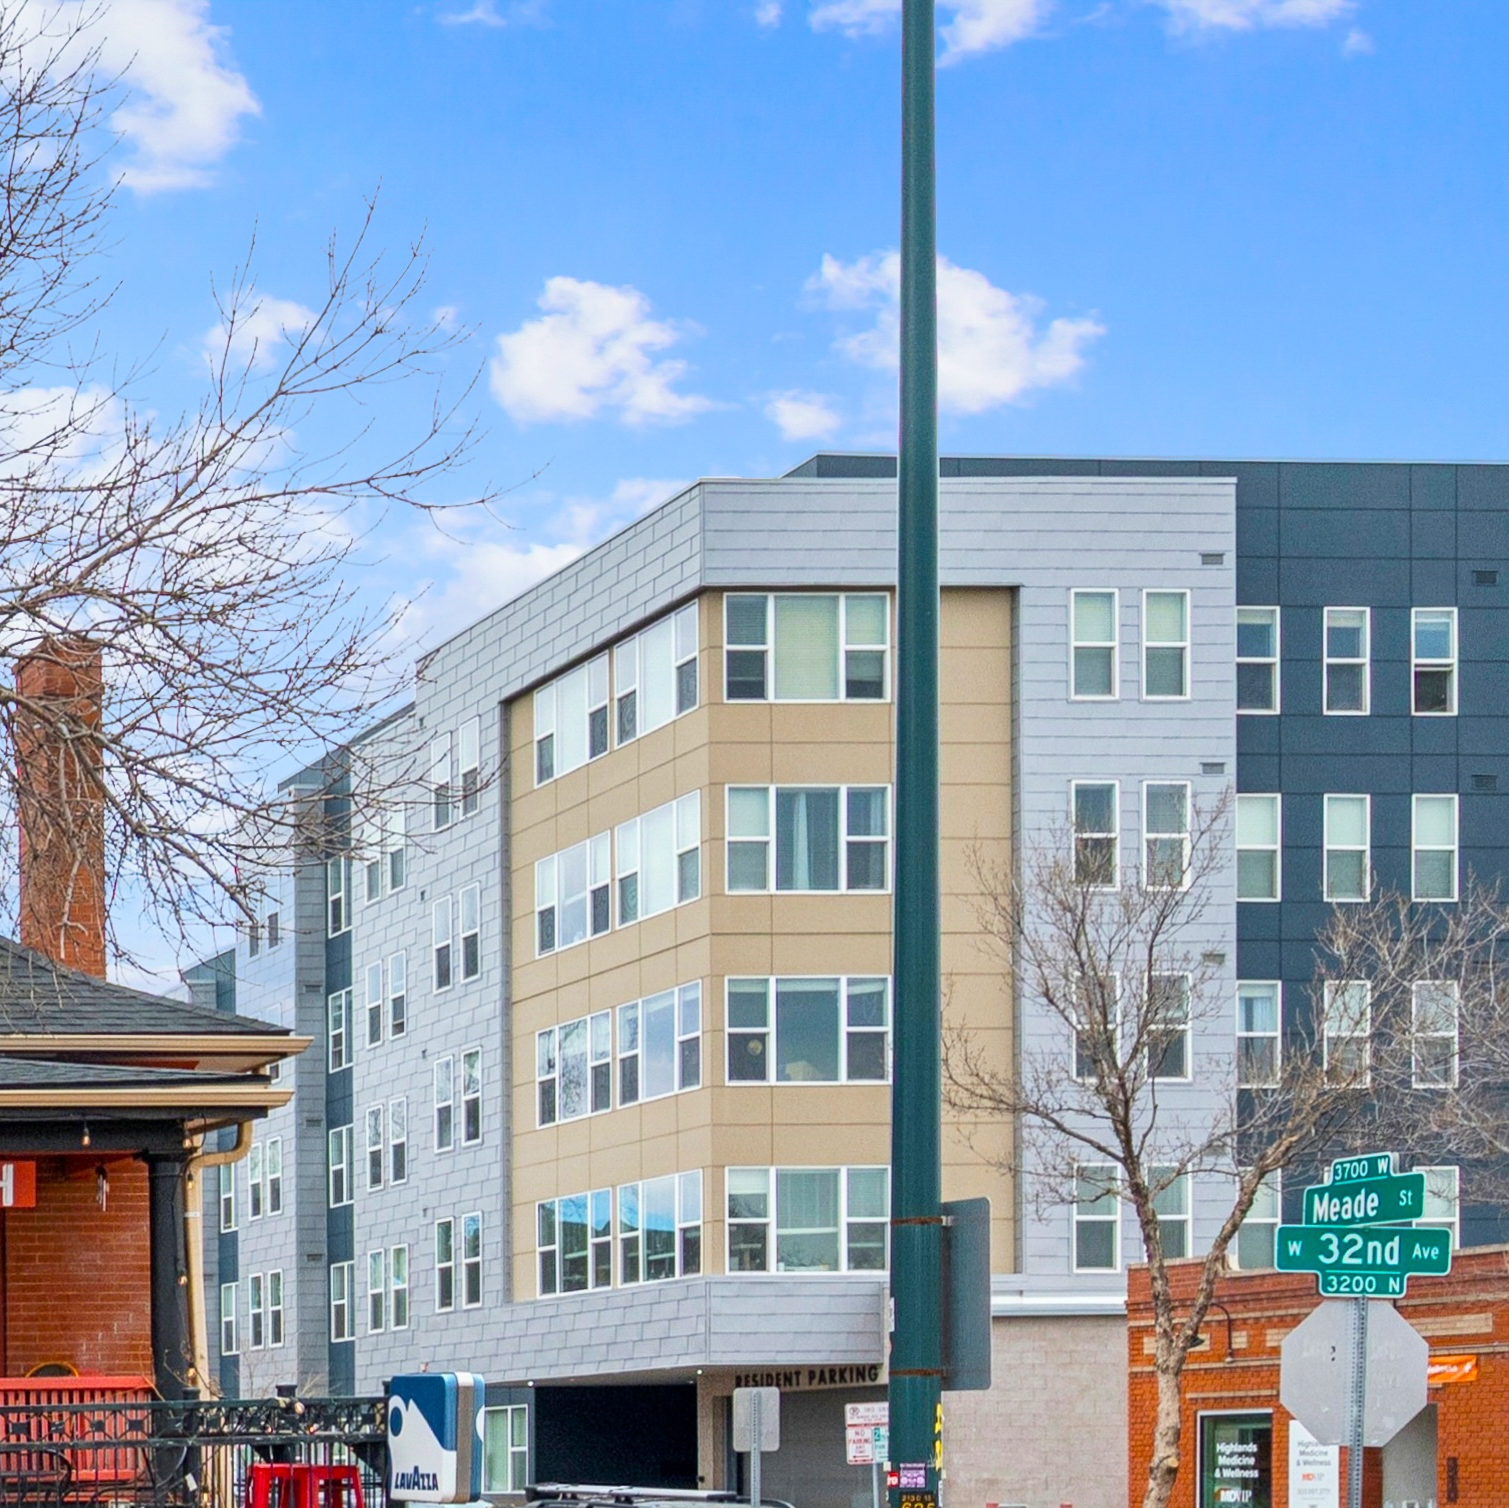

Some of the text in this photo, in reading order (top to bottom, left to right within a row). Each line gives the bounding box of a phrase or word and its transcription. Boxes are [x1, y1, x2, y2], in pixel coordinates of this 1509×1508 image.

[1334, 1157, 1389, 1181] 3700 W
[1312, 1187, 1413, 1224] Meade St
[1288, 1232, 1439, 1265] W 32nd Ave
[1326, 1275, 1400, 1293] 3200 N
[735, 1365, 879, 1389] RESIDENT PARKING
[1216, 1442, 1258, 1455] Highlands
[1299, 1449, 1328, 1457] Medicine
[1218, 1454, 1256, 1466] Medicine
[1302, 1458, 1331, 1467] Wellness
[394, 1465, 439, 1491] LAVAZZA
[1222, 1467, 1259, 1478] Wellness
